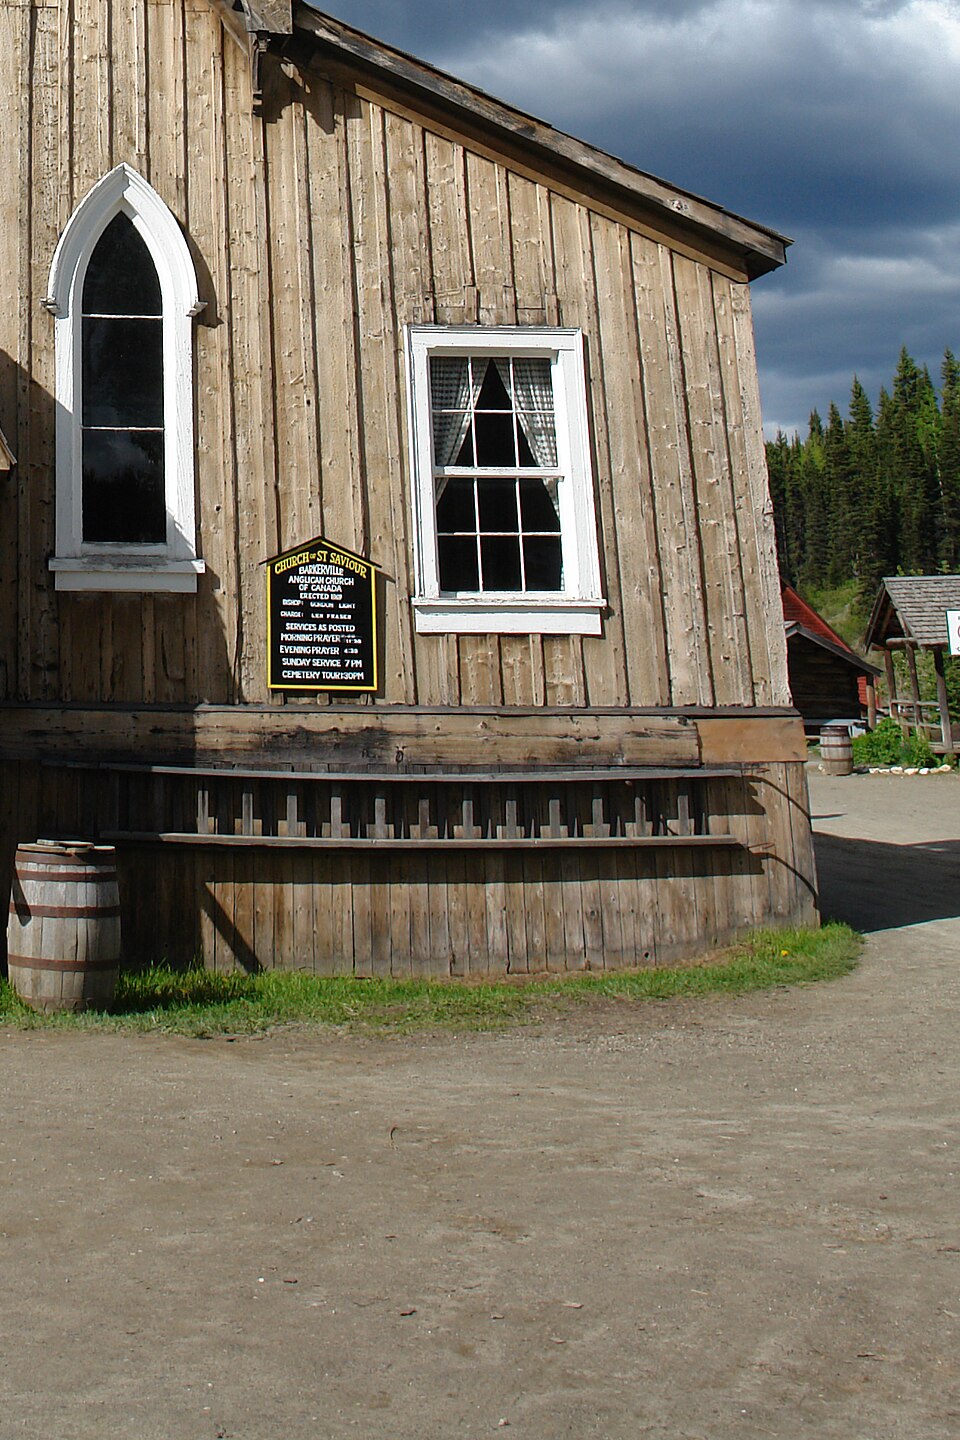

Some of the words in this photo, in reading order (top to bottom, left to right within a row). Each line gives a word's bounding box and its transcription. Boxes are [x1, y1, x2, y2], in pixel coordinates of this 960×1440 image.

[274, 552, 310, 574] CHURCH
[317, 550, 328, 562] ST
[330, 552, 367, 578] SAVIOUR
[298, 564, 344, 576] BARKERVILLE
[288, 576, 324, 584] ANGLICAN
[325, 576, 354, 586] CHURCH
[311, 584, 342, 592] CANADA
[286, 622, 316, 631] SERVICES
[280, 633, 313, 642] MORNING
[314, 634, 340, 643] PRAYER
[280, 645, 312, 654] EVENING
[312, 646, 340, 655] PRAYER
[282, 658, 311, 666] SUNDAY
[312, 659, 342, 667] SERVICE
[282, 670, 320, 679] CEMETERY
